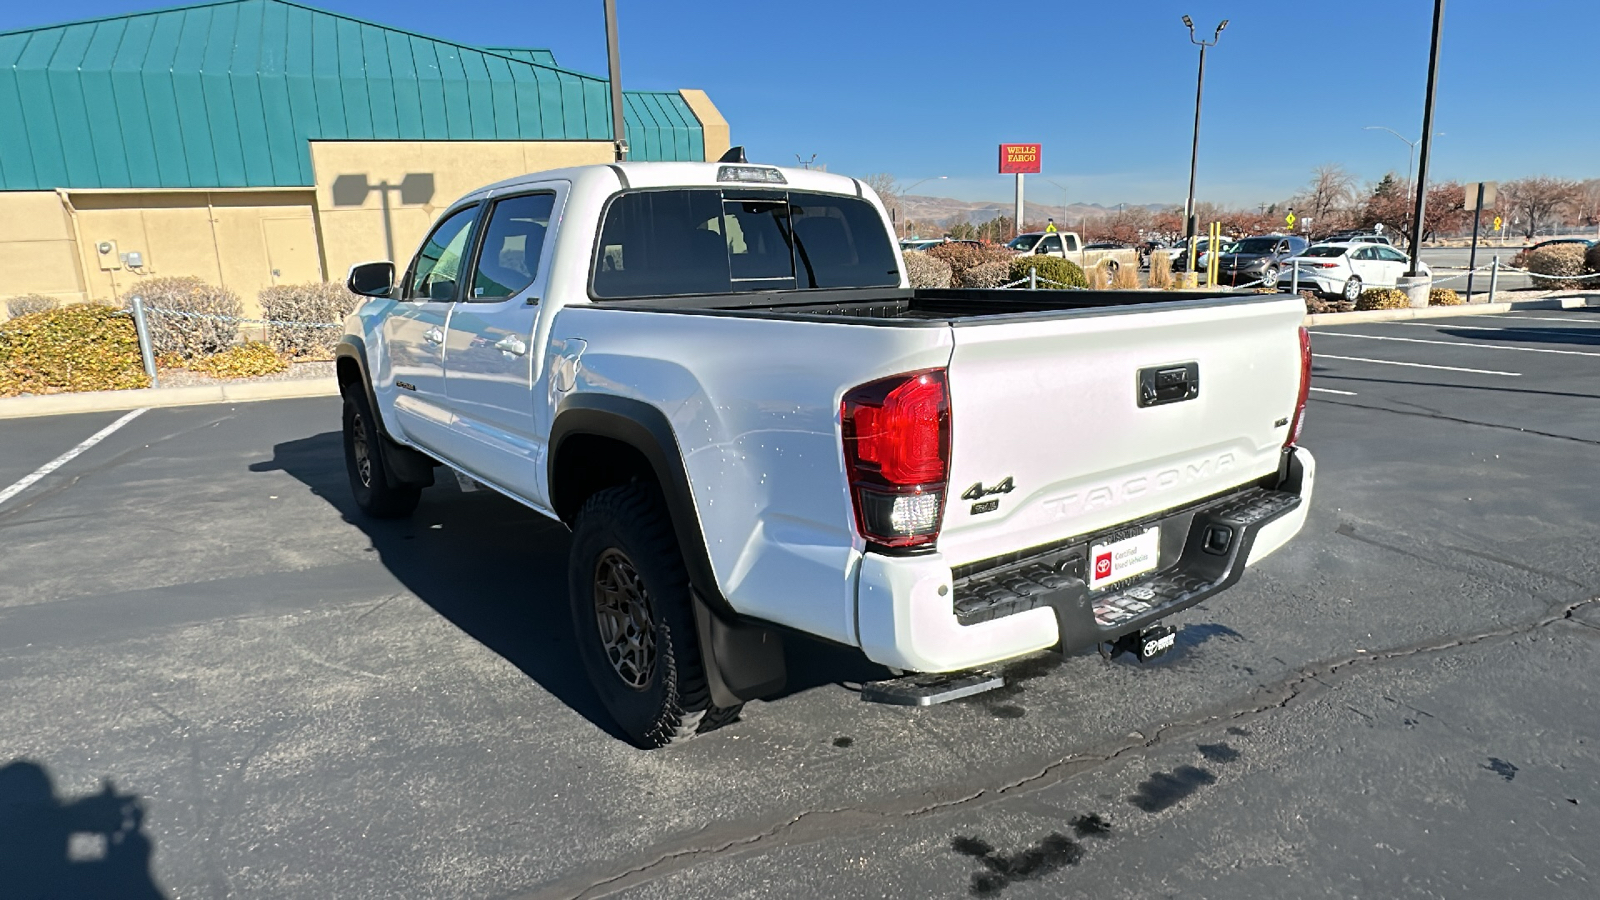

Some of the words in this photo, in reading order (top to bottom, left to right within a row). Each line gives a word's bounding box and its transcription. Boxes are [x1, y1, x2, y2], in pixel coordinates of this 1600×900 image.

[1007, 146, 1037, 154] WELLS
[1008, 154, 1036, 162] FARGO
[1042, 453, 1237, 518] TACOMA
[1115, 546, 1138, 560] Certified
